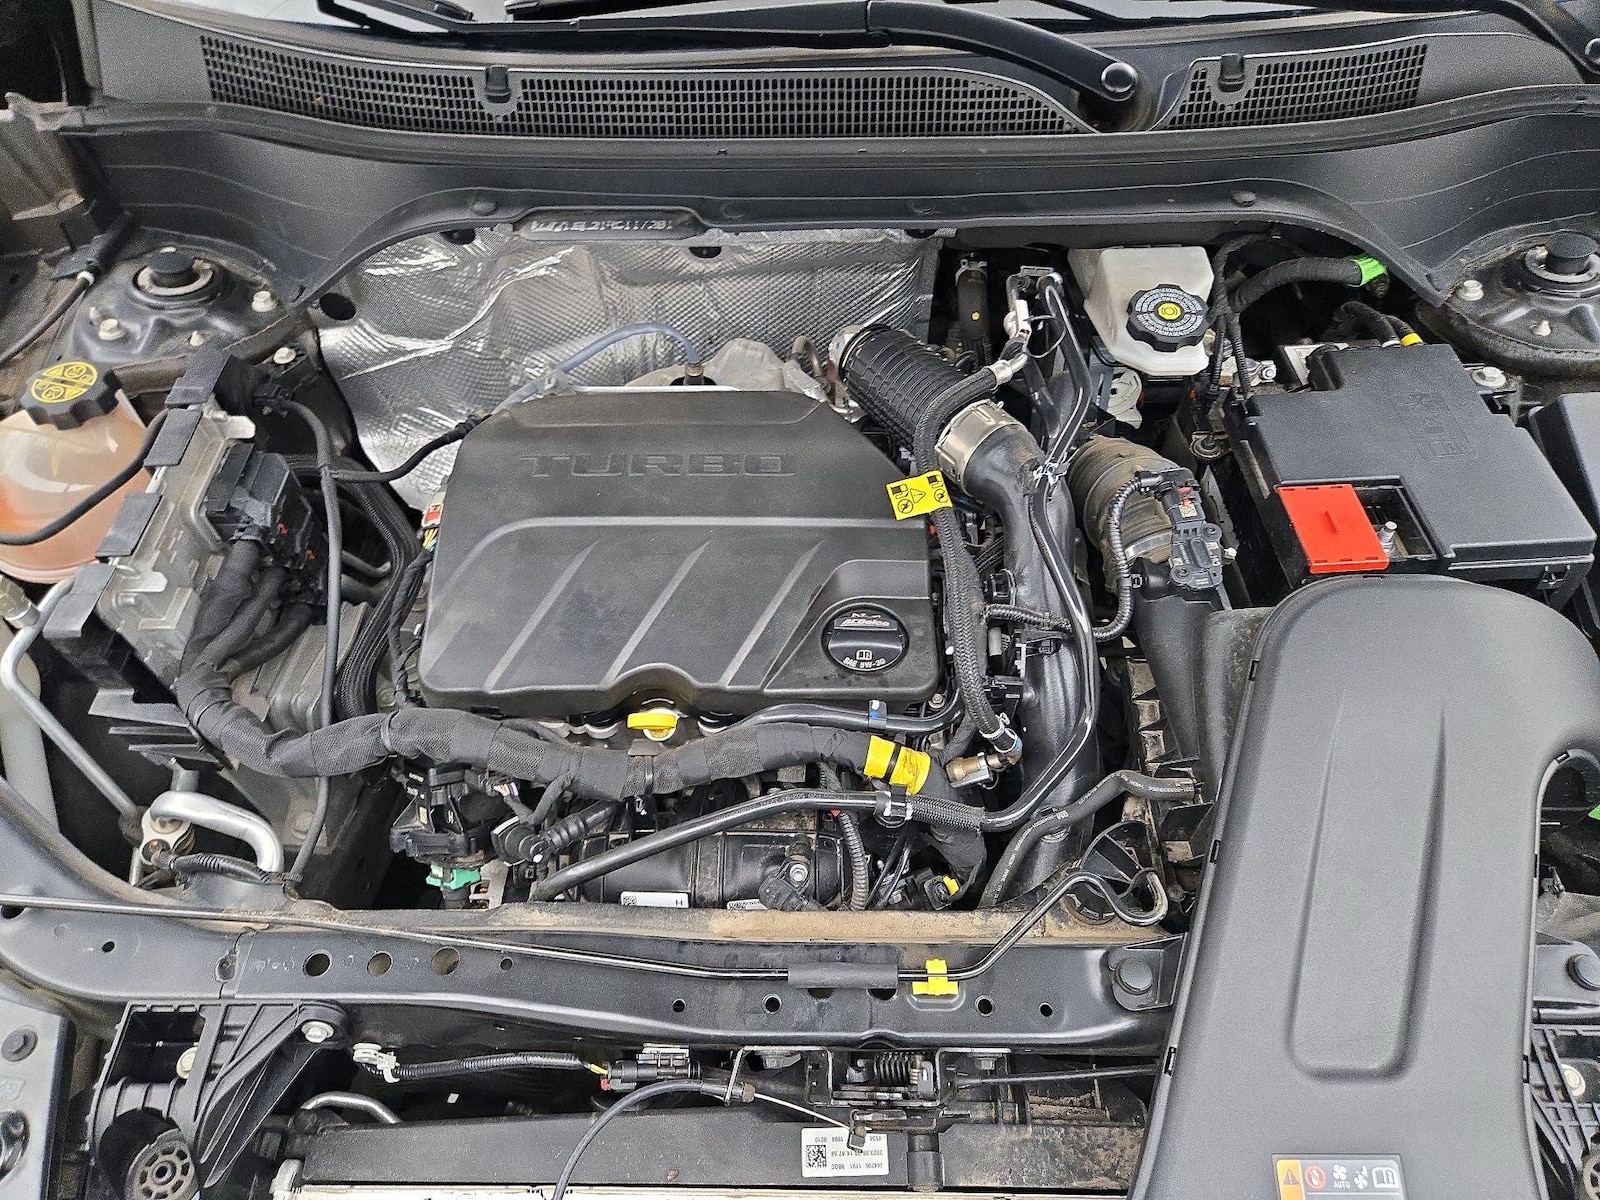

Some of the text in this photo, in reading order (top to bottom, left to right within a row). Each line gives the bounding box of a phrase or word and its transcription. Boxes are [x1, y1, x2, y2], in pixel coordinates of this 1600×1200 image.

[519, 453, 795, 477] TURBO
[839, 618, 890, 627] ACDelco
[843, 657, 886, 669] SAE 5W-30
[1333, 1180, 1351, 1189] AUTO
